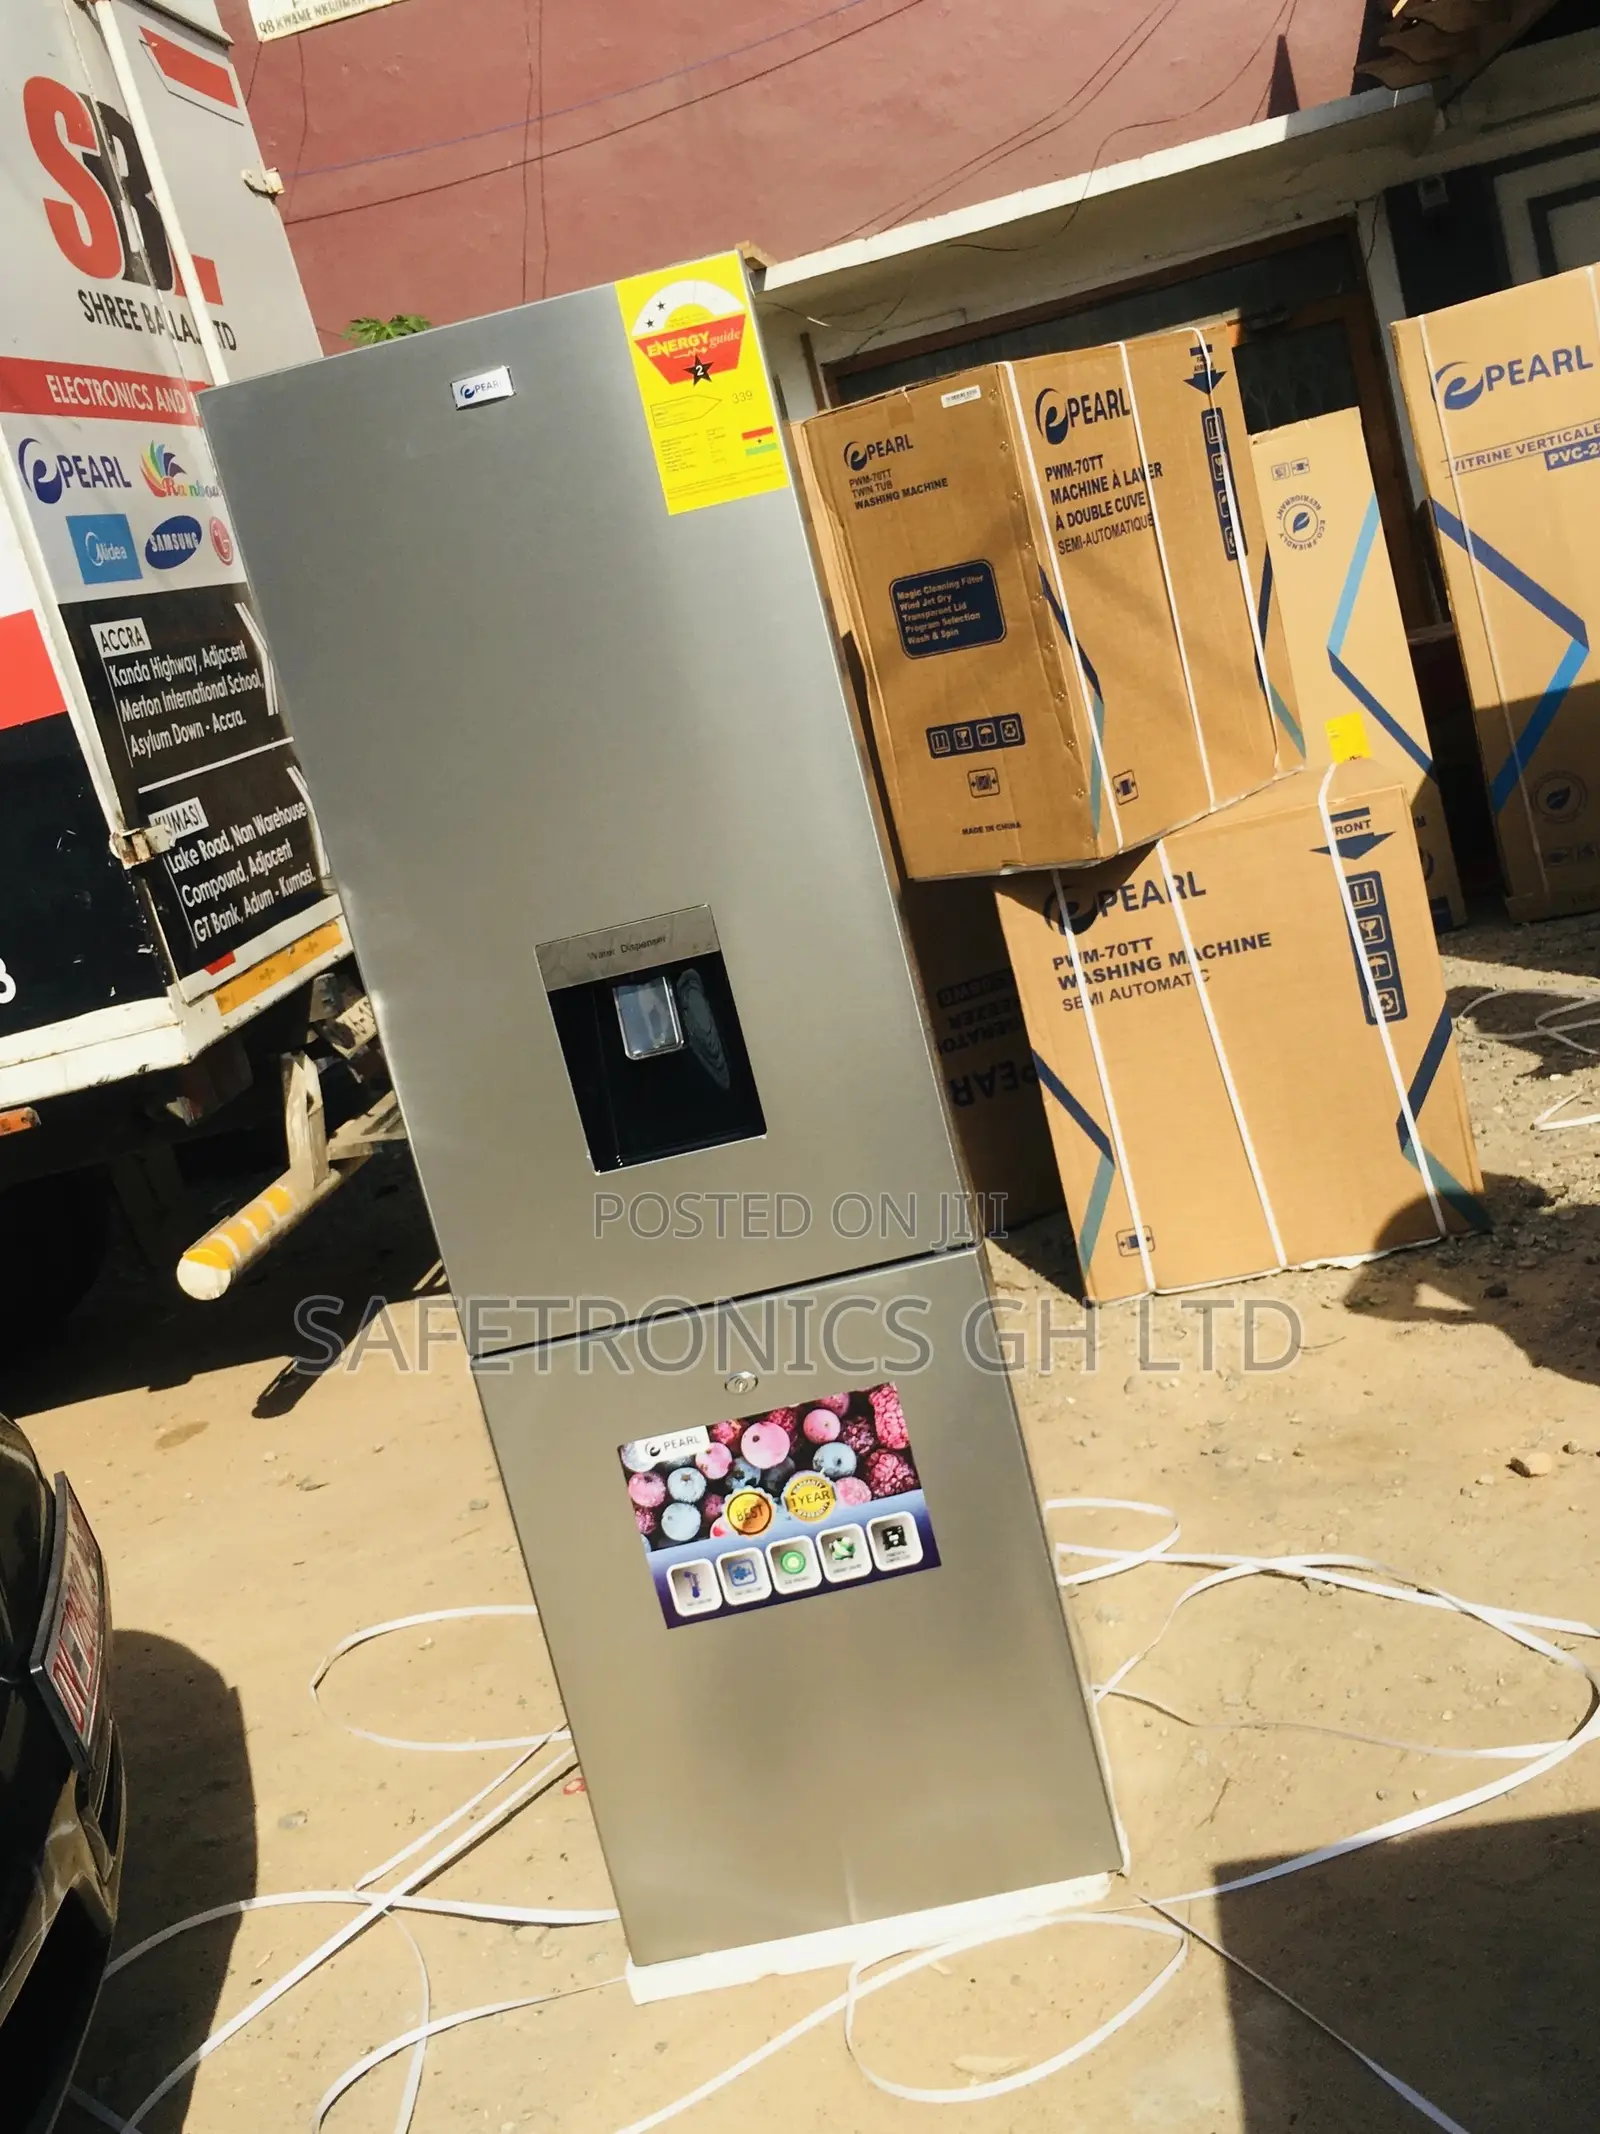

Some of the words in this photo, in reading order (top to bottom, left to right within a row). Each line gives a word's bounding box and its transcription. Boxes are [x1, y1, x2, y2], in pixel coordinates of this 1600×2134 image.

[78, 289, 142, 332] SHREE
[211, 319, 237, 351] TD
[647, 330, 709, 358] ENERGY
[709, 327, 741, 349] guide
[695, 364, 705, 376] 2
[45, 374, 154, 411] ELECTRONICS
[155, 386, 187, 414] AND
[732, 390, 753, 404] 339
[1515, 423, 1600, 455] VERTICALE
[849, 469, 893, 488] PWM-70TT
[1045, 455, 1104, 482] PWM-70TT
[852, 485, 874, 499] TWIN
[875, 480, 893, 492] TUB
[854, 491, 901, 510] WASHING
[901, 478, 949, 498] MACHINE
[1050, 476, 1110, 505] MACHINE
[1066, 502, 1113, 528] DOUBLE
[1114, 491, 1146, 513] CUVE
[150, 531, 200, 553] SAMSUNG
[1058, 512, 1156, 555] SEMI-AUTOMATIQUE
[897, 589, 921, 600] Magic
[923, 580, 960, 594] Cleaning
[961, 575, 984, 587] Filter
[900, 601, 921, 612] Wind
[922, 597, 935, 608] Jet
[937, 594, 952, 604] Dry
[902, 607, 952, 622] Transparent
[953, 602, 967, 612] Lid
[905, 621, 941, 634] Program
[941, 612, 980, 626] Selection
[100, 626, 145, 652] ACCRA
[907, 634, 931, 645] Wash
[940, 628, 960, 640] Spin
[109, 660, 150, 688] Kanda
[149, 654, 202, 682] Highway,
[201, 640, 248, 670] Adjacent
[120, 695, 163, 722] Merton
[161, 675, 228, 712] International
[227, 668, 265, 694] School,
[131, 729, 176, 758] Asylum
[171, 721, 205, 744] Down
[211, 709, 247, 733] Accra.
[168, 846, 200, 874] Lake
[197, 829, 235, 862] Road,
[230, 824, 257, 847] Nan
[252, 801, 307, 834] Warehouse
[1334, 819, 1371, 836] RONT
[181, 860, 250, 908] Compound,
[246, 838, 294, 876] Adjacent
[193, 917, 212, 942] GT
[210, 903, 244, 935] Bank,
[242, 889, 275, 918] Adum
[278, 863, 317, 897] Kumasi.
[620, 935, 666, 953] Dispenser
[663, 1434, 701, 1452] PEARL
[798, 1490, 830, 1505] YEAR
[736, 1503, 763, 1523] BEST
